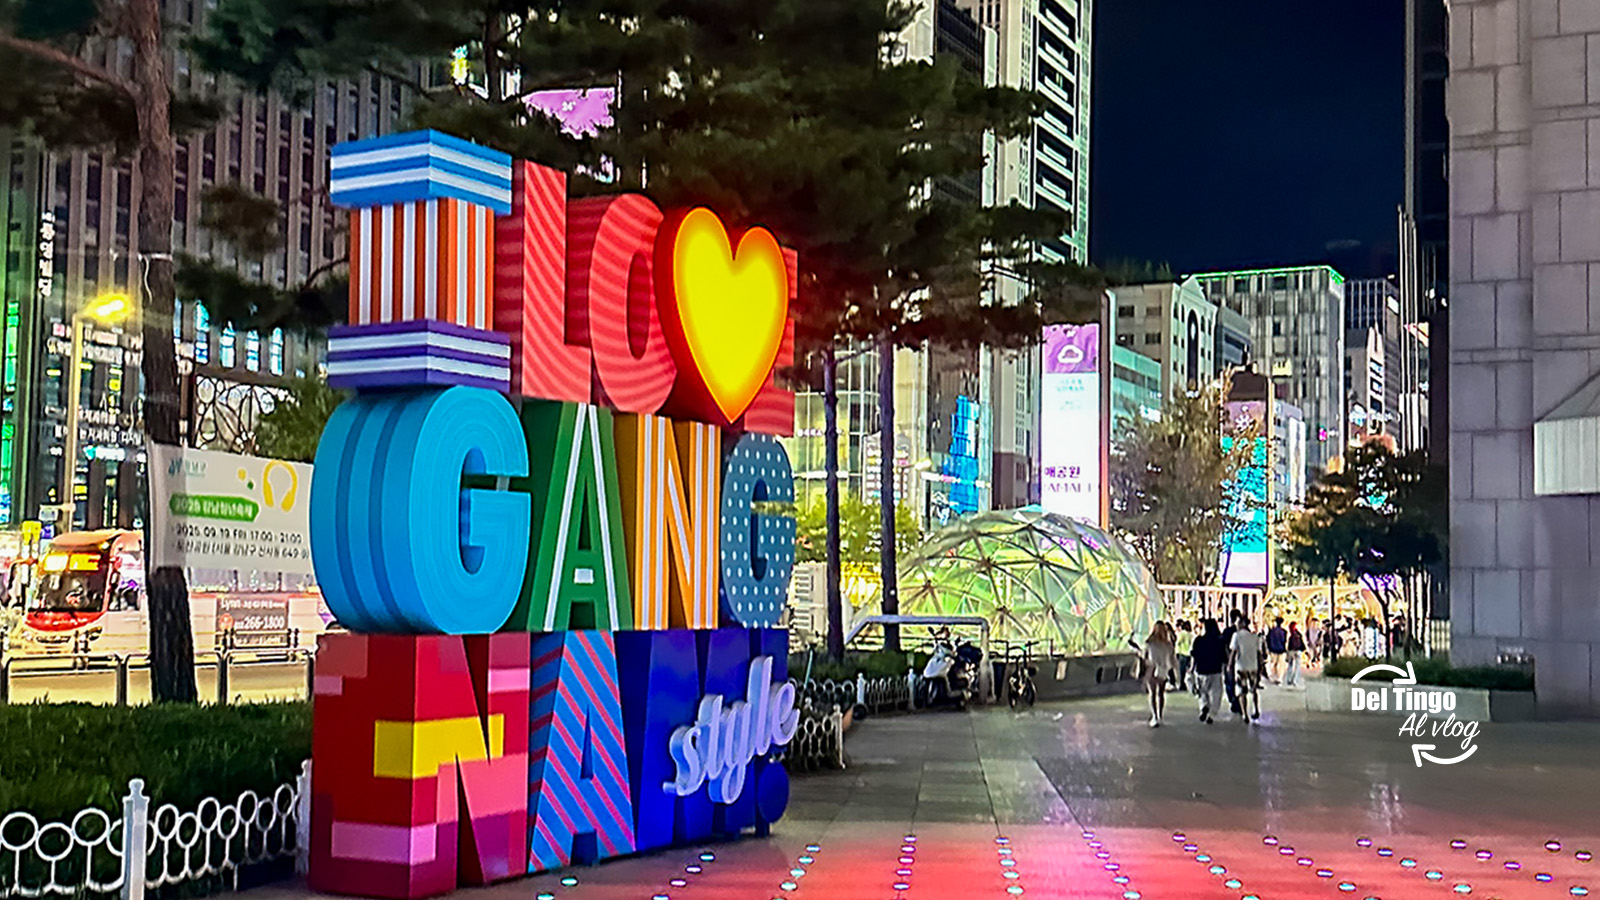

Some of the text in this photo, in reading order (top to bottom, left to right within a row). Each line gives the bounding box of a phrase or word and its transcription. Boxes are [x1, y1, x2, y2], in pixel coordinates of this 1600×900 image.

[327, 129, 513, 393] I
[309, 386, 797, 634] GANG
[662, 654, 801, 805] style
